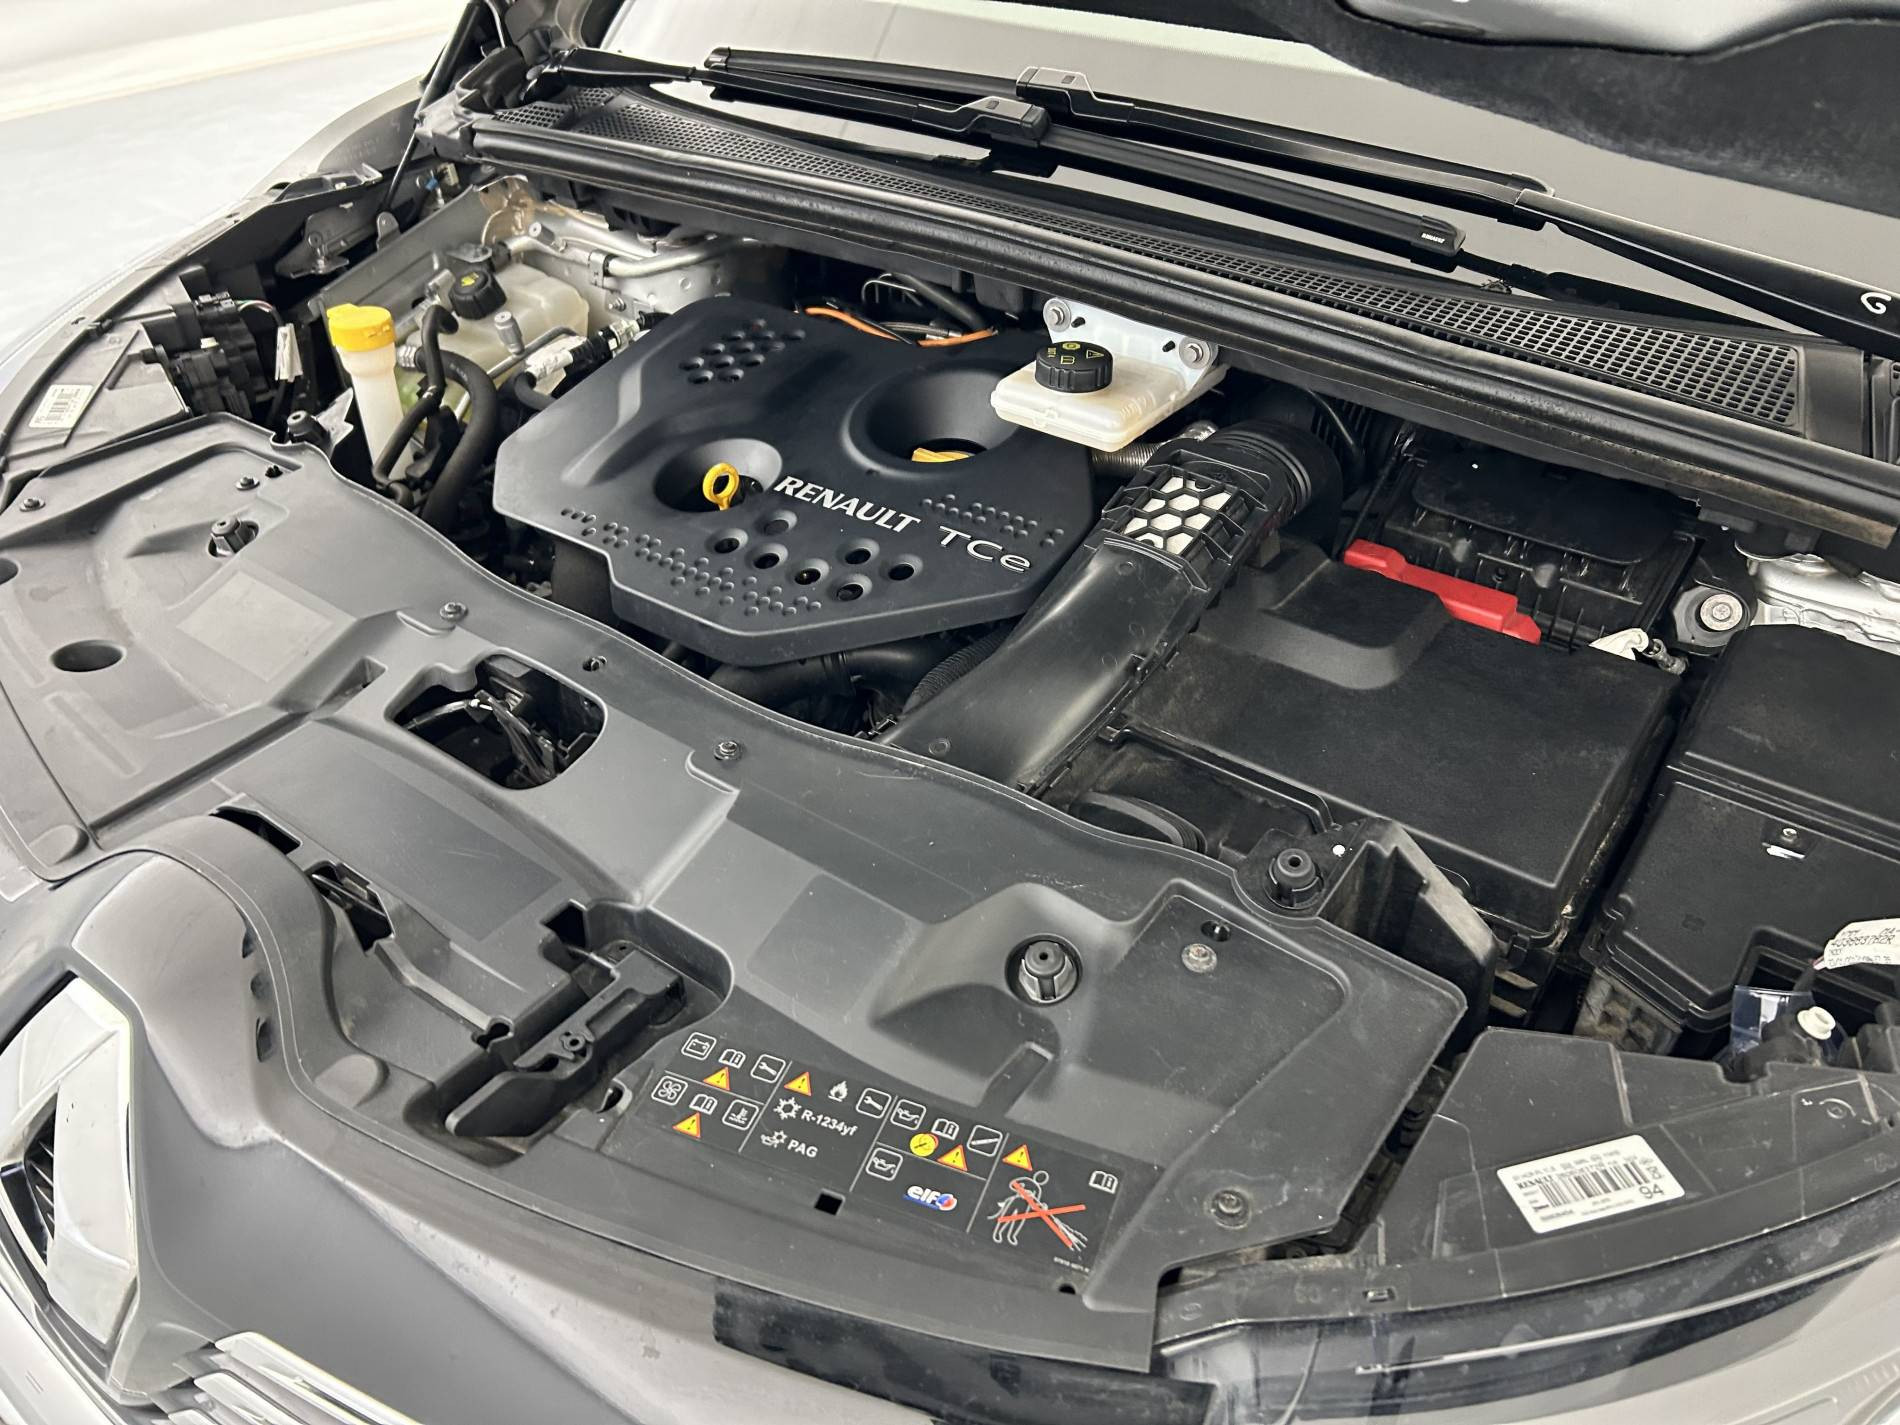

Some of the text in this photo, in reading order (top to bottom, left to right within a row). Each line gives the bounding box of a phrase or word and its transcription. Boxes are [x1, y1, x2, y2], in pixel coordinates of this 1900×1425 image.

[774, 475, 1032, 573] RENAULT TCe
[800, 1109, 859, 1137] R-1234yf
[787, 1138, 819, 1159] PAG
[906, 1185, 944, 1206] elf
[1638, 1183, 1665, 1200] 94
